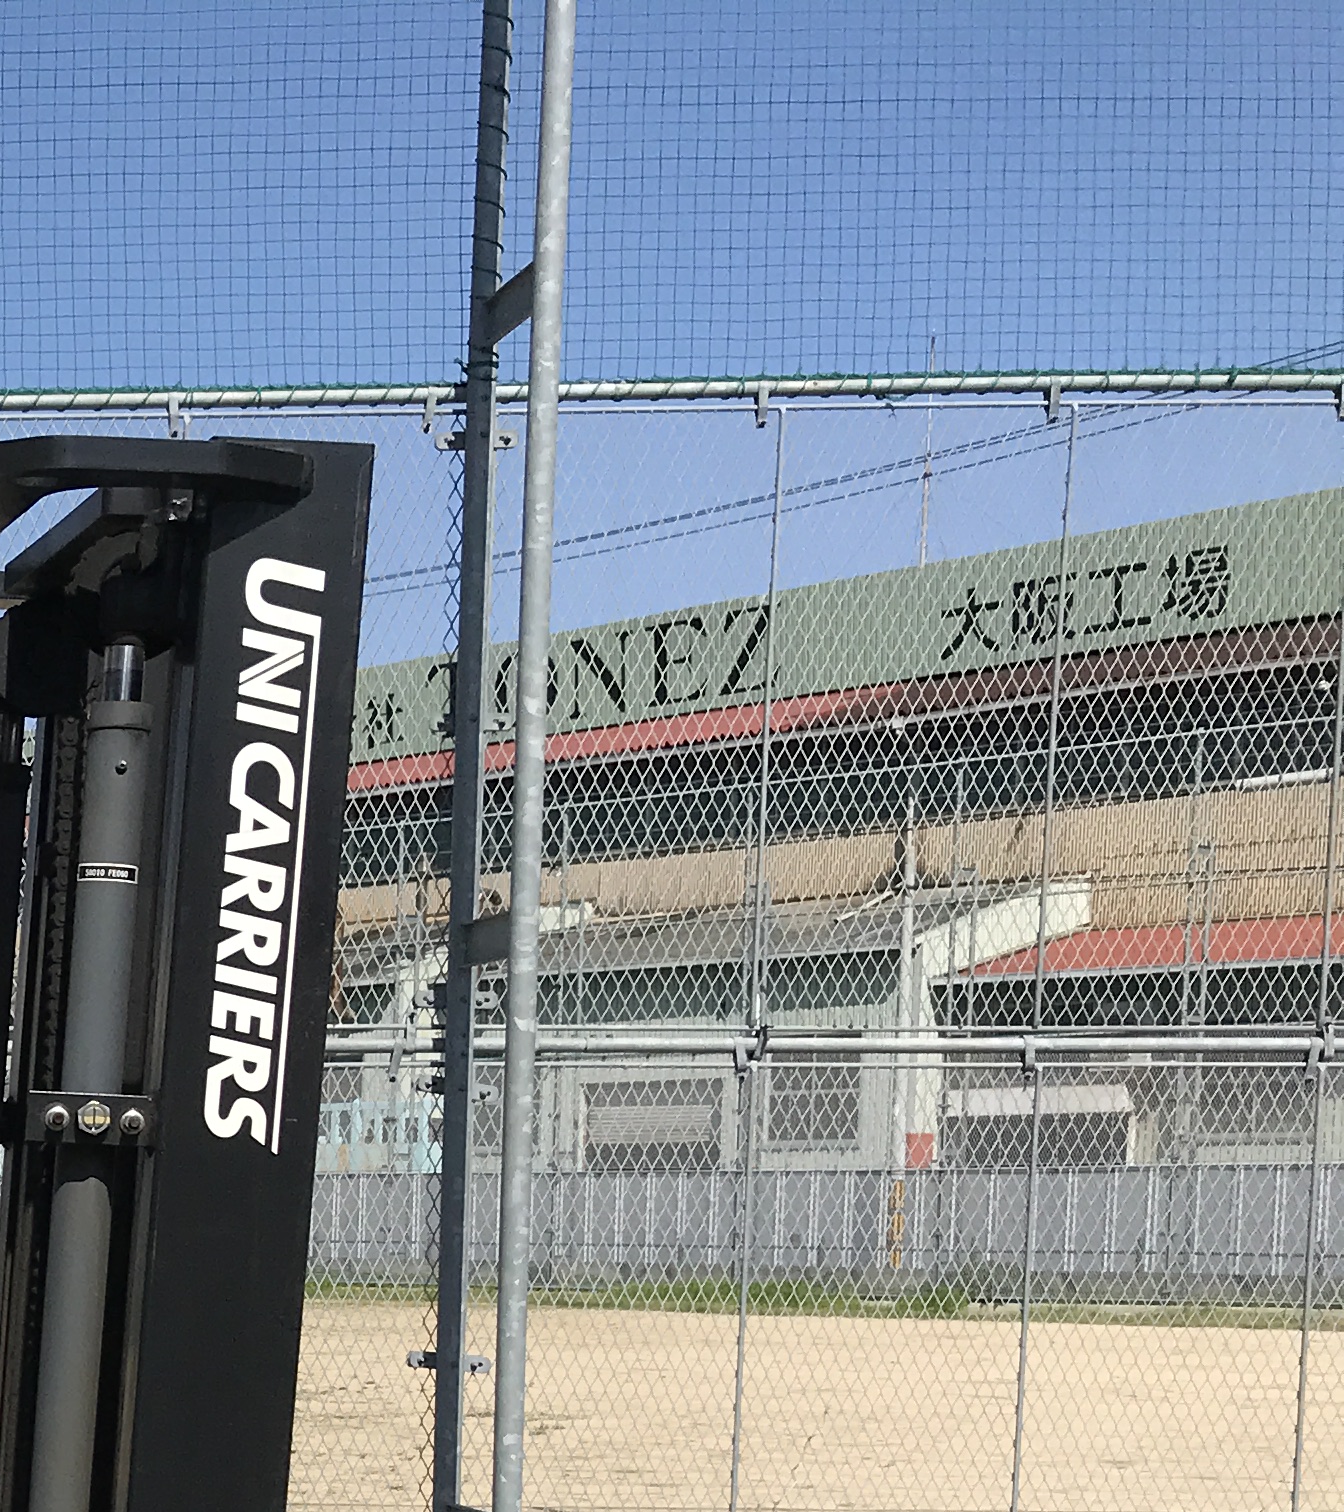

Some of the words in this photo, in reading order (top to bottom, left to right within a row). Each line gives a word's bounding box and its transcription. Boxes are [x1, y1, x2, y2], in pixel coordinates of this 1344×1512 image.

[941, 545, 1232, 660] 大阪工場
[204, 557, 326, 1151] UNICARRIERS
